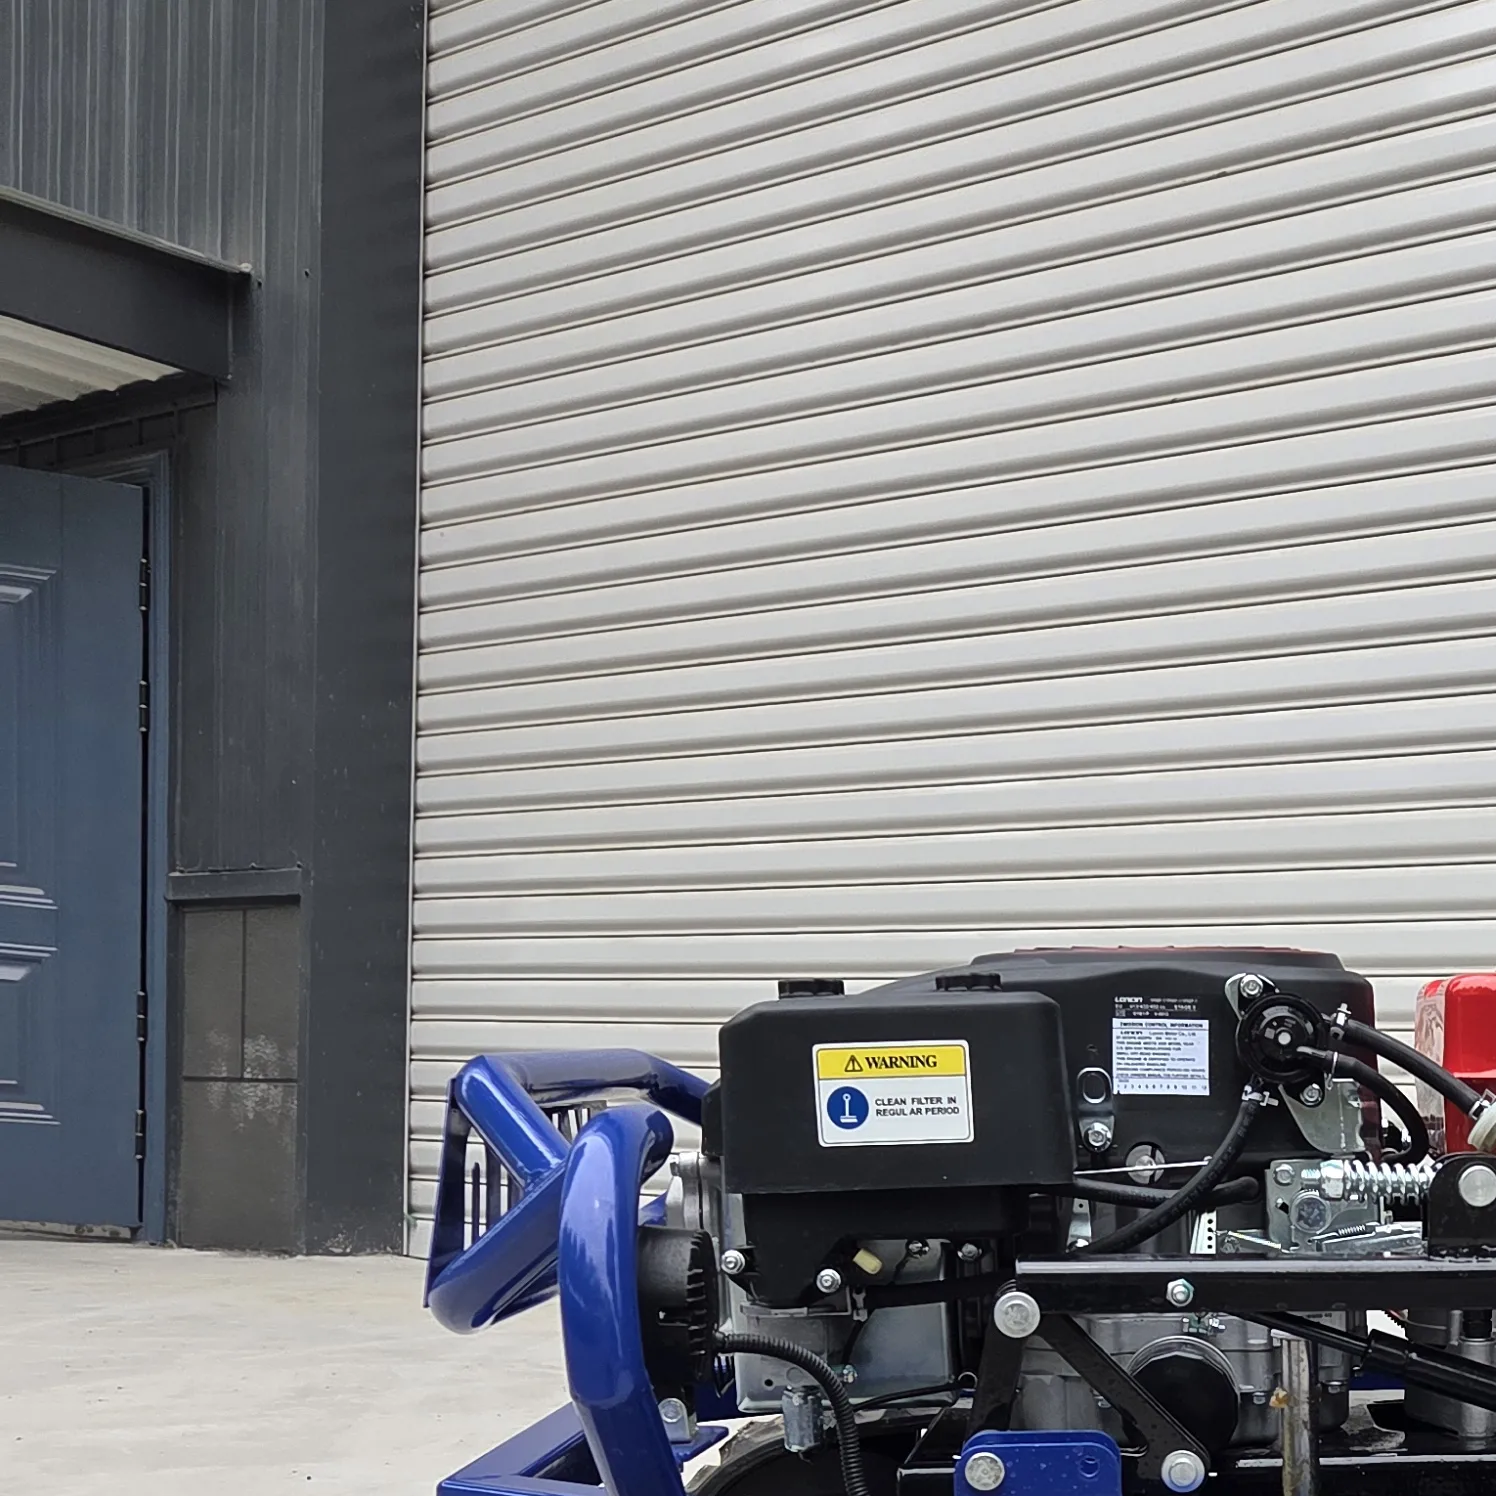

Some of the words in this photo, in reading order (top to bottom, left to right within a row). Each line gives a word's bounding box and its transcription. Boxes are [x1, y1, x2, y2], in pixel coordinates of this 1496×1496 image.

[865, 1054, 937, 1069] WARNING
[875, 1097, 907, 1106] CLEAN
[911, 1097, 943, 1105] FILTER
[947, 1096, 957, 1104] IN
[925, 1106, 959, 1115] PERIOD
